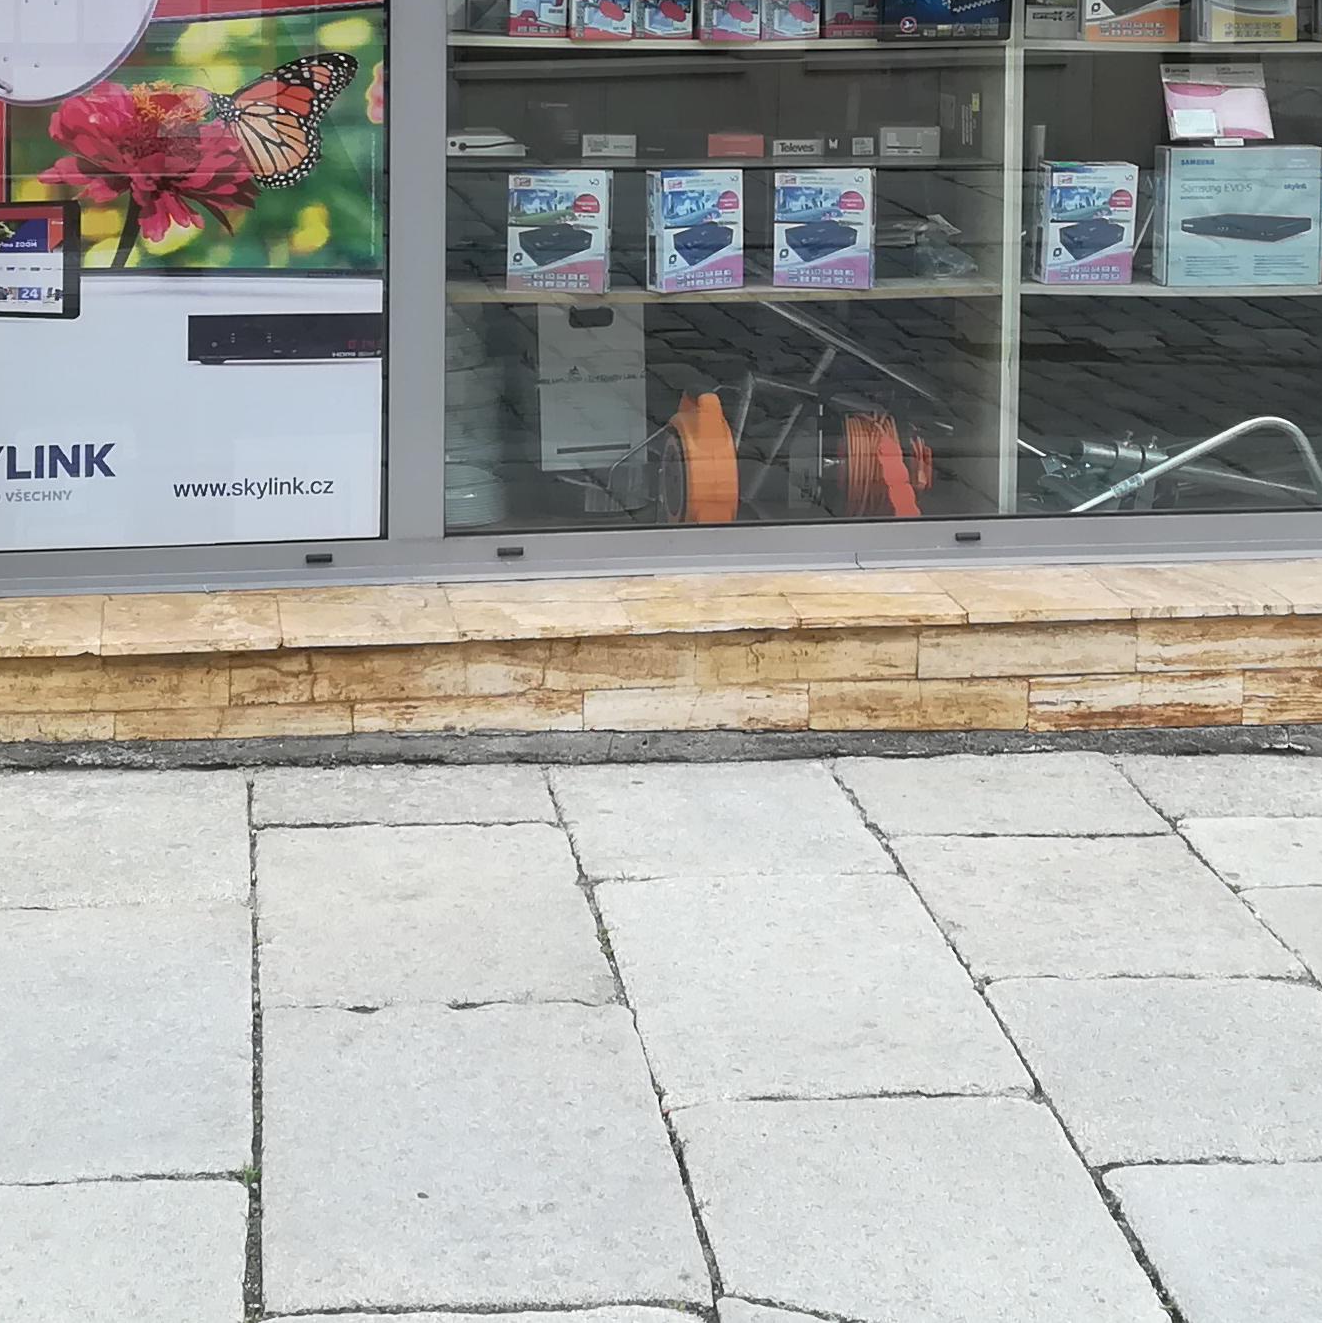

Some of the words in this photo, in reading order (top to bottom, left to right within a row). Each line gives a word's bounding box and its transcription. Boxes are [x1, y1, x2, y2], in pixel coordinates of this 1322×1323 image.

[1180, 182, 1222, 194] Samsung
[21, 288, 39, 299] 24
[173, 476, 335, 499] www.skylink.cz
[5, 487, 73, 504] VŠECHNY
